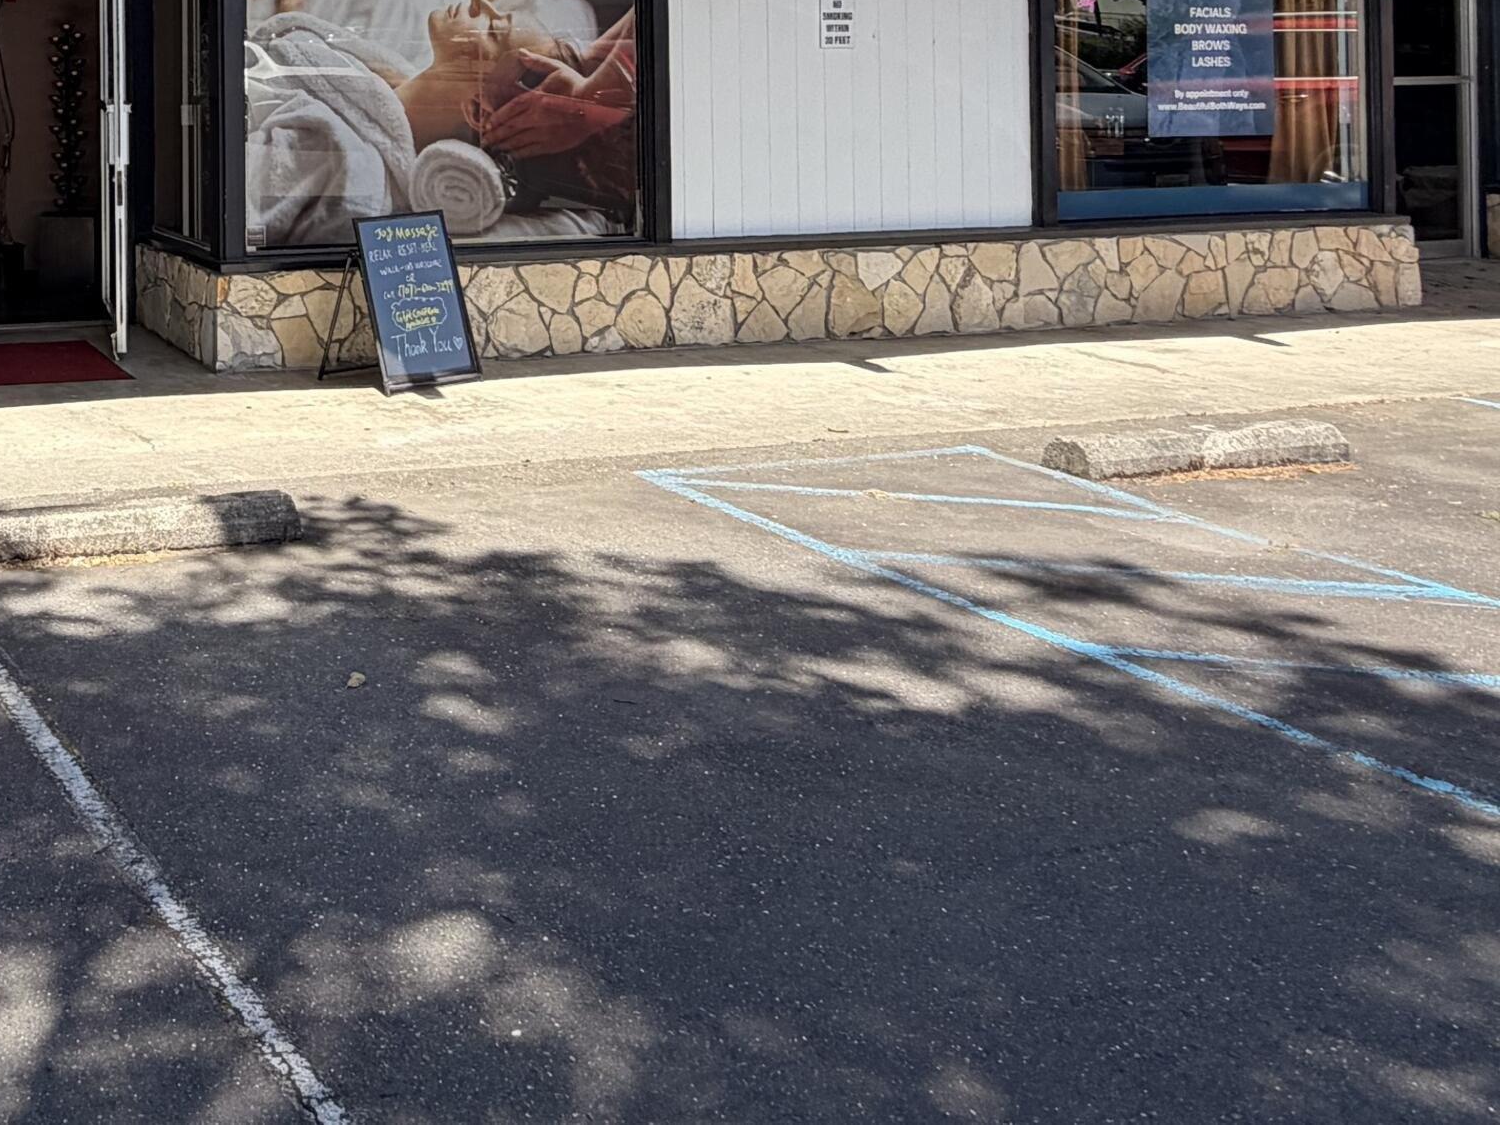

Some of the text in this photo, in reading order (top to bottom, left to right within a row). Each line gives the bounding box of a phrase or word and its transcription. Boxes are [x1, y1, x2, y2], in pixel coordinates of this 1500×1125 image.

[832, 0, 842, 9] NO
[822, 12, 853, 21] SMOKING
[1189, 7, 1232, 17] FACIALS
[826, 24, 849, 32] WITHIN
[1174, 23, 1248, 35] BODY WAXING
[834, 35, 851, 45] FEET
[1191, 40, 1231, 51] BROWS
[1191, 56, 1232, 67] LASHES
[1174, 90, 1250, 99] By appointment only
[1158, 102, 1267, 111] www.BeautifulBothWays.com
[395, 224, 439, 242] Massage
[368, 248, 393, 263] RELAX
[390, 325, 453, 362] Thank You
